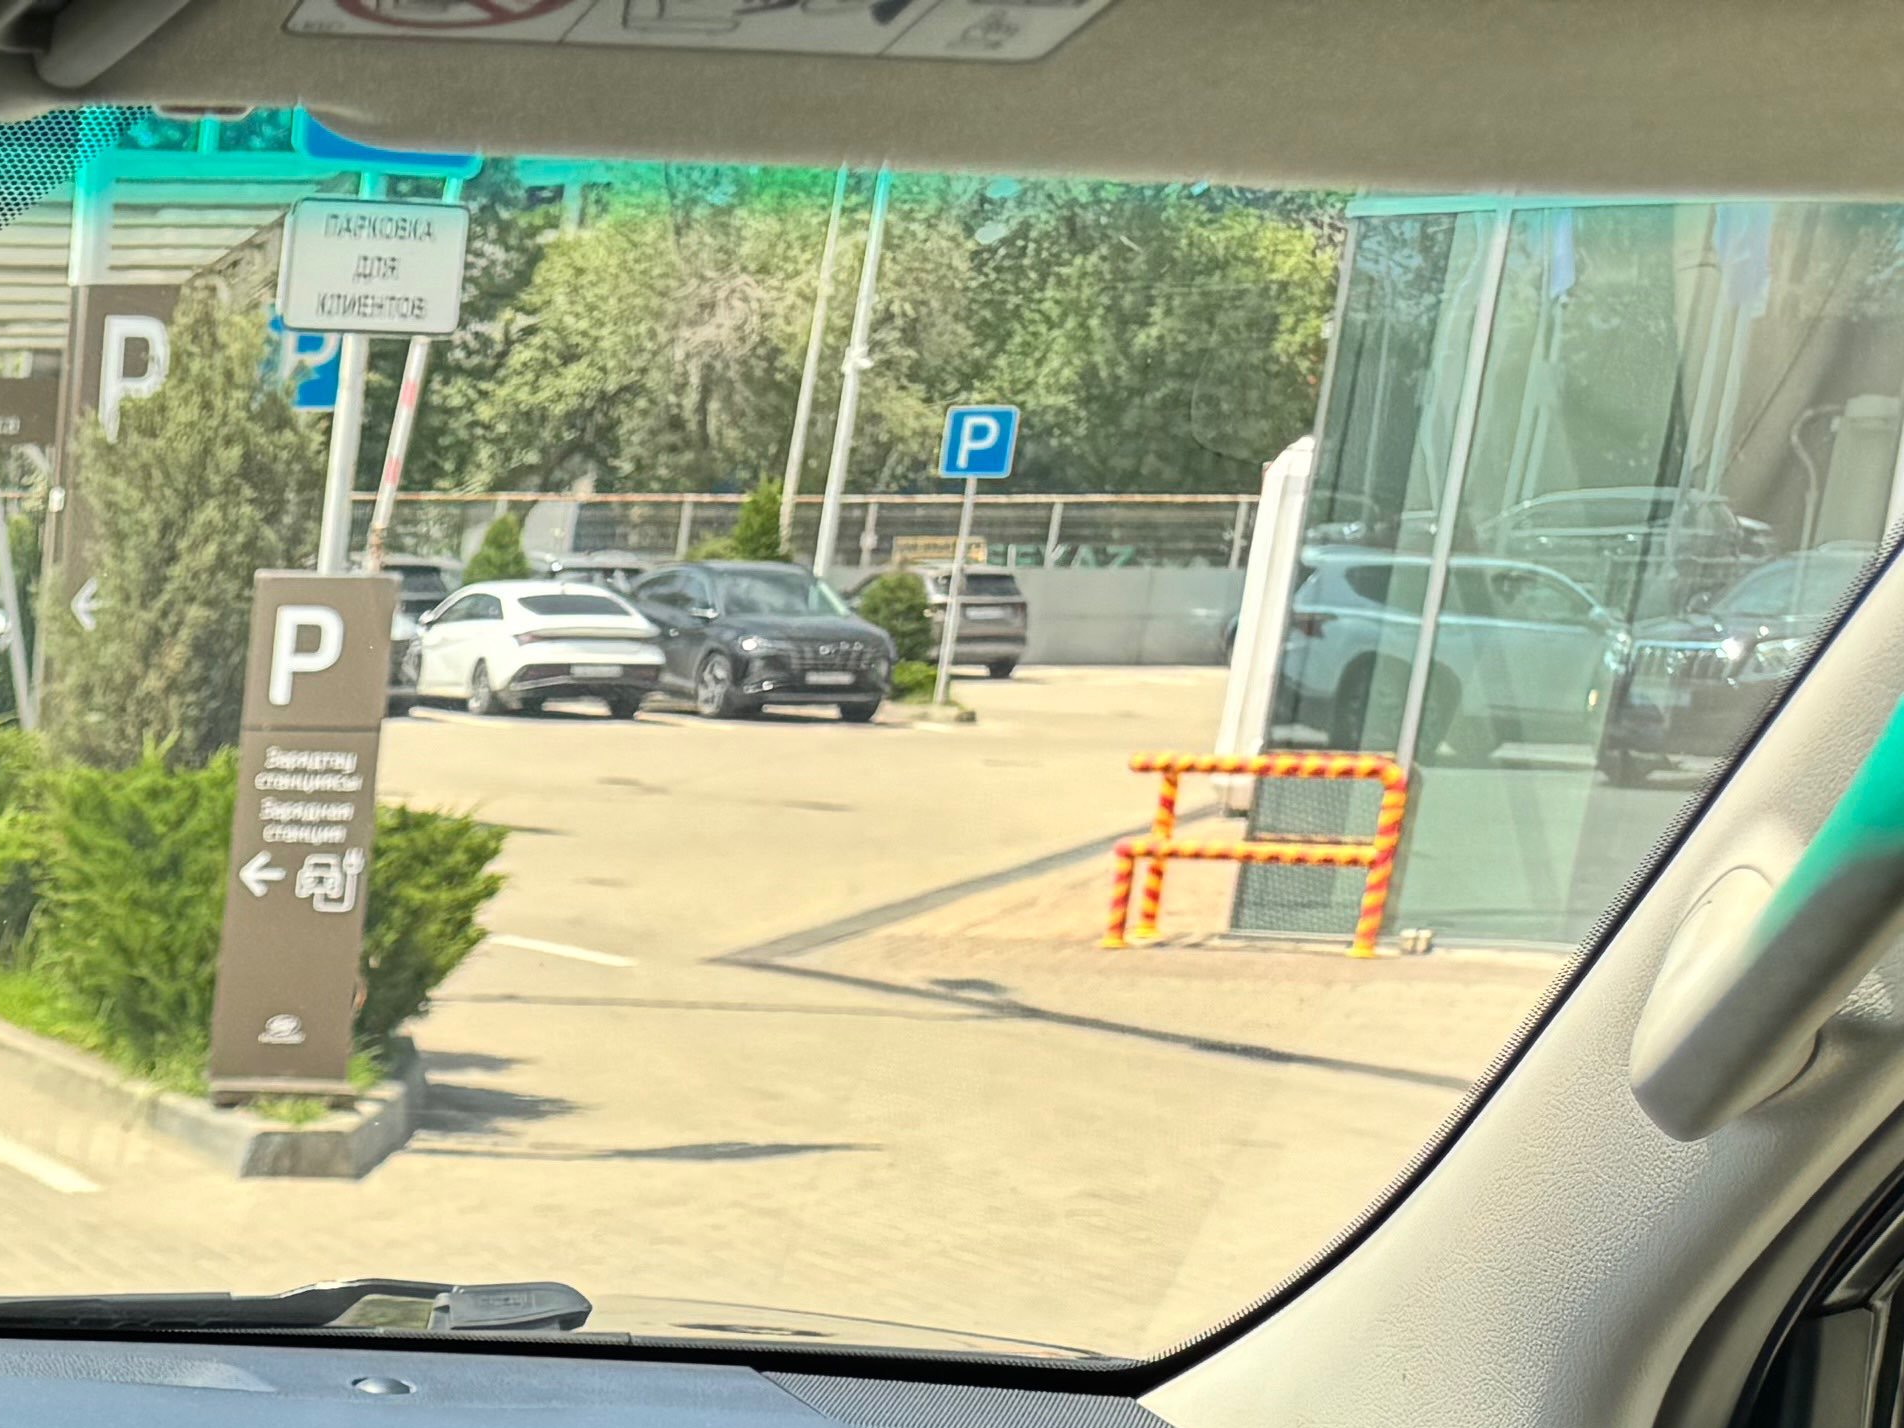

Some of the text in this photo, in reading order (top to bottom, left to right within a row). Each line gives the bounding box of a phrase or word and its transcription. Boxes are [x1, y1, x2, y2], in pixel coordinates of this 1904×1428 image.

[324, 213, 435, 241] ПАРКОВКА
[352, 256, 399, 283] ДЛЯ
[316, 293, 427, 320] КЛИЕНТОВ
[957, 416, 1001, 470] P
[268, 604, 344, 706] P
